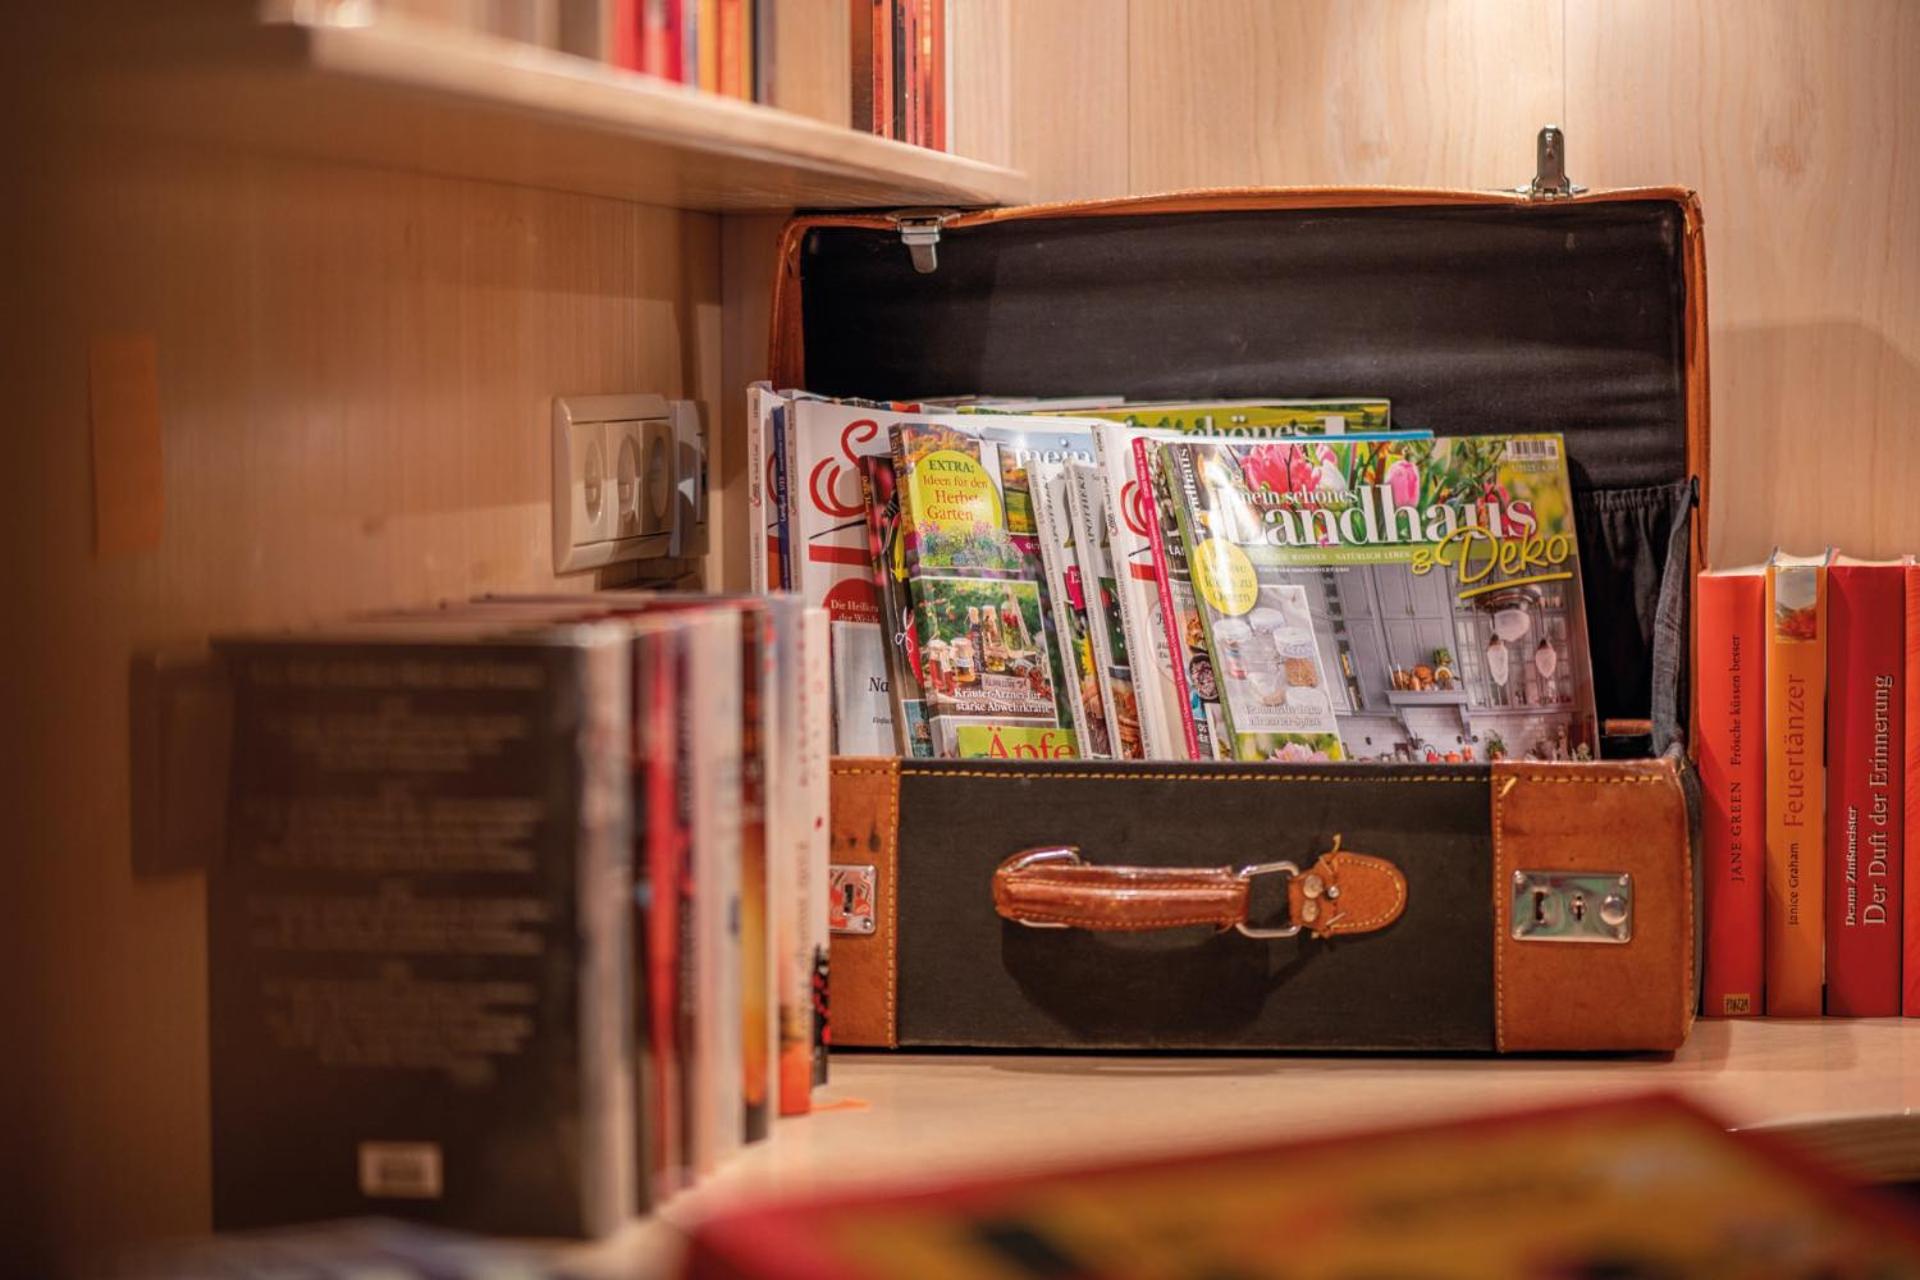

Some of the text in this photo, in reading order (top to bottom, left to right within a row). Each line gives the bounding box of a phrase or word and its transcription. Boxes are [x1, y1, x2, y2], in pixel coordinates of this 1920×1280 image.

[1187, 415, 1309, 438] chönes
[929, 460, 974, 474] EXTRA:
[927, 504, 973, 521] Garten
[1213, 484, 1537, 547] Landhaus
[1435, 525, 1569, 584] Deko
[830, 600, 846, 609] Die
[868, 677, 890, 692] Na
[987, 722, 1077, 759] Äpfe
[1730, 634, 1744, 883] JANE GREEN Frösche küssen besser
[1783, 673, 1806, 926] Janice Graham Feuertänzer
[1863, 674, 1893, 925] Der Duft der Erinnerung
[1845, 806, 1857, 926] Deana Zinßmeister
